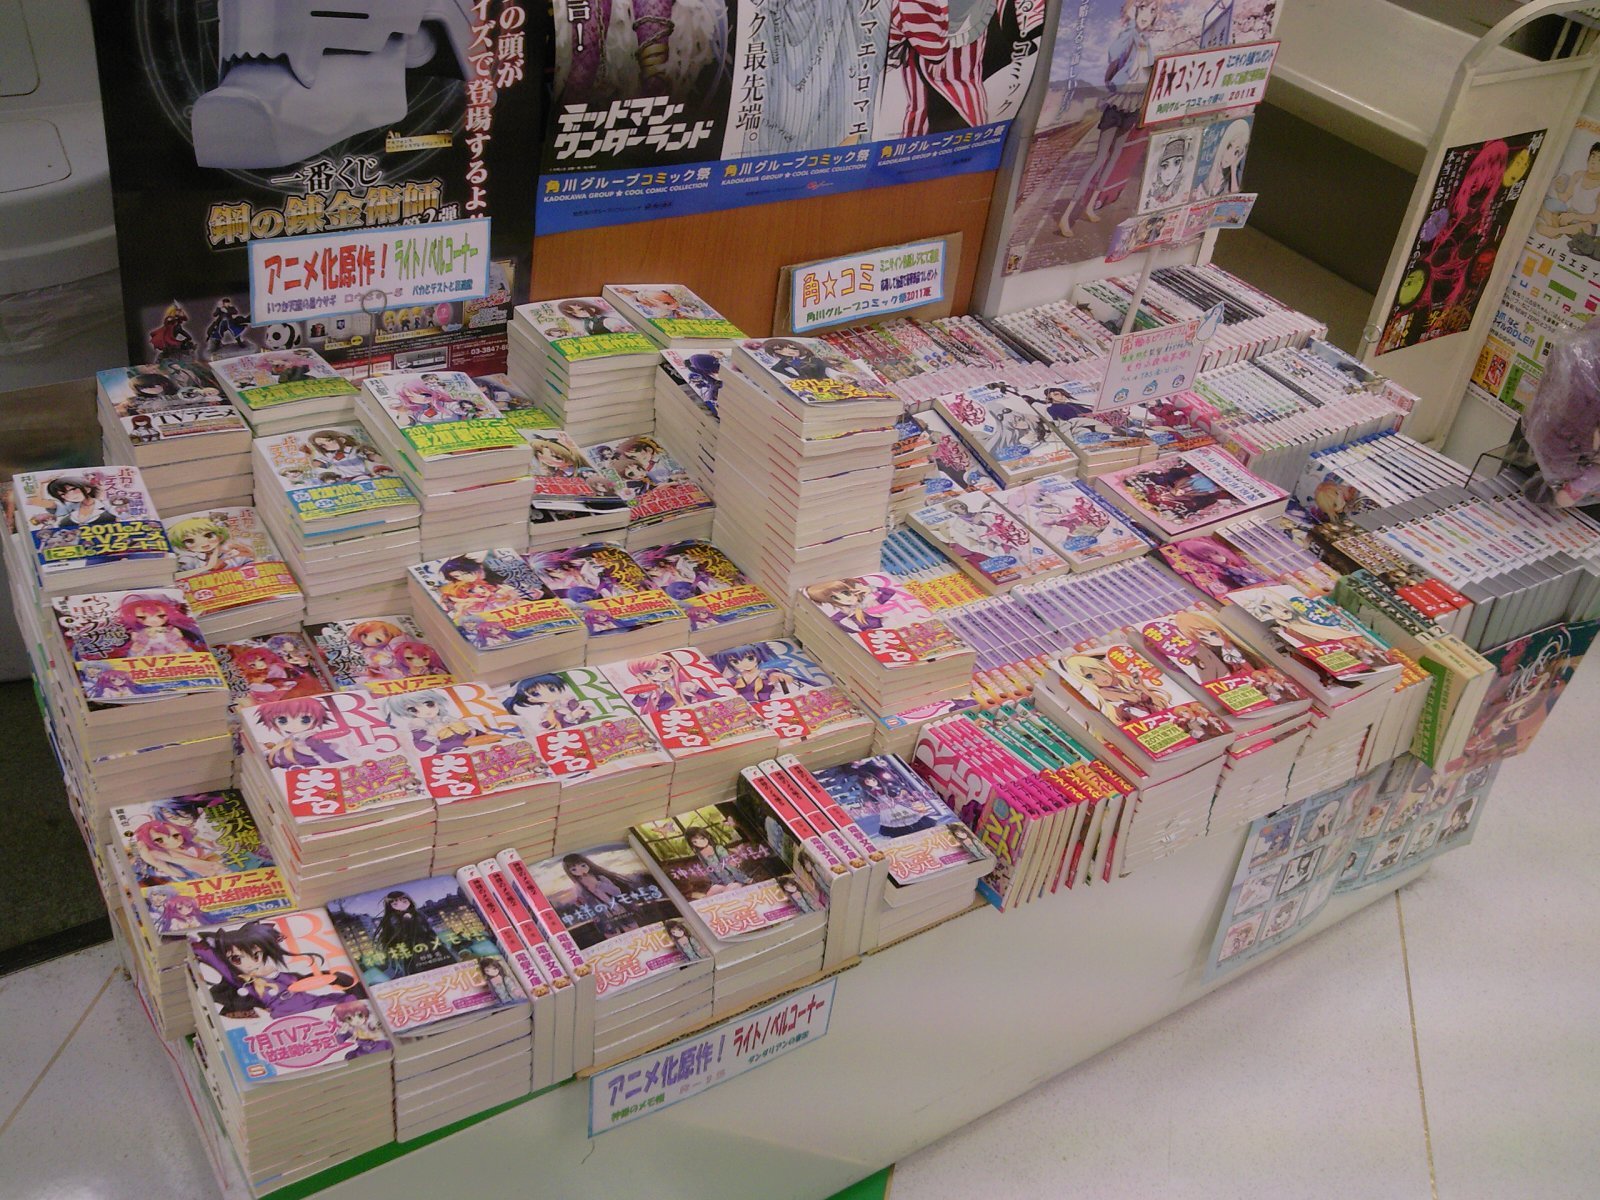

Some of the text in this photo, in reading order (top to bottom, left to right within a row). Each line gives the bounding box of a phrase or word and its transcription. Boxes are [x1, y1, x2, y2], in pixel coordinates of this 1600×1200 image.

[497, 0, 526, 89] の頭が
[465, 0, 497, 219] イズで登場するよ
[558, 96, 685, 132] デッドマン
[553, 120, 714, 160] ワンダーランド
[880, 124, 1006, 157] 角川グループコミック祭
[271, 156, 382, 193] 一番くじ
[721, 175, 760, 187] KADOKAWA
[761, 172, 784, 181] GROUP
[791, 169, 809, 178] COOL
[810, 167, 830, 176] COMIC
[724, 148, 871, 178] 角川グループコミック祭
[543, 181, 709, 203] KADOKAWA GROUP COOL COMIC COLLECTION
[545, 166, 712, 194] 角川グループコミック祭
[207, 179, 442, 246] 鋼の錬金術師
[264, 243, 388, 295] アニメ化原作!
[394, 231, 479, 281] ライトノベルコーナー
[490, 600, 563, 620] TVアニメ
[598, 591, 666, 609] TVアニメ
[696, 585, 762, 605] TVアニメ
[122, 654, 212, 669] TVアニメ
[129, 662, 217, 680] 放送開始!!
[377, 675, 454, 695] TVアニメ
[1204, 674, 1256, 694] TVアニメ
[1122, 711, 1178, 736] TVアニメ
[186, 868, 278, 894] TVアニメ
[194, 880, 287, 907] 放送開始!!
[701, 884, 788, 923] アニメ化
[709, 910, 766, 937] 決定
[377, 964, 487, 1010] アニメ化
[386, 994, 453, 1027] 決定
[732, 993, 826, 1057] ライトノベルコーナー
[244, 1017, 343, 1053] 7月 TVアニメ
[607, 1033, 727, 1107] アニメ化原作!
